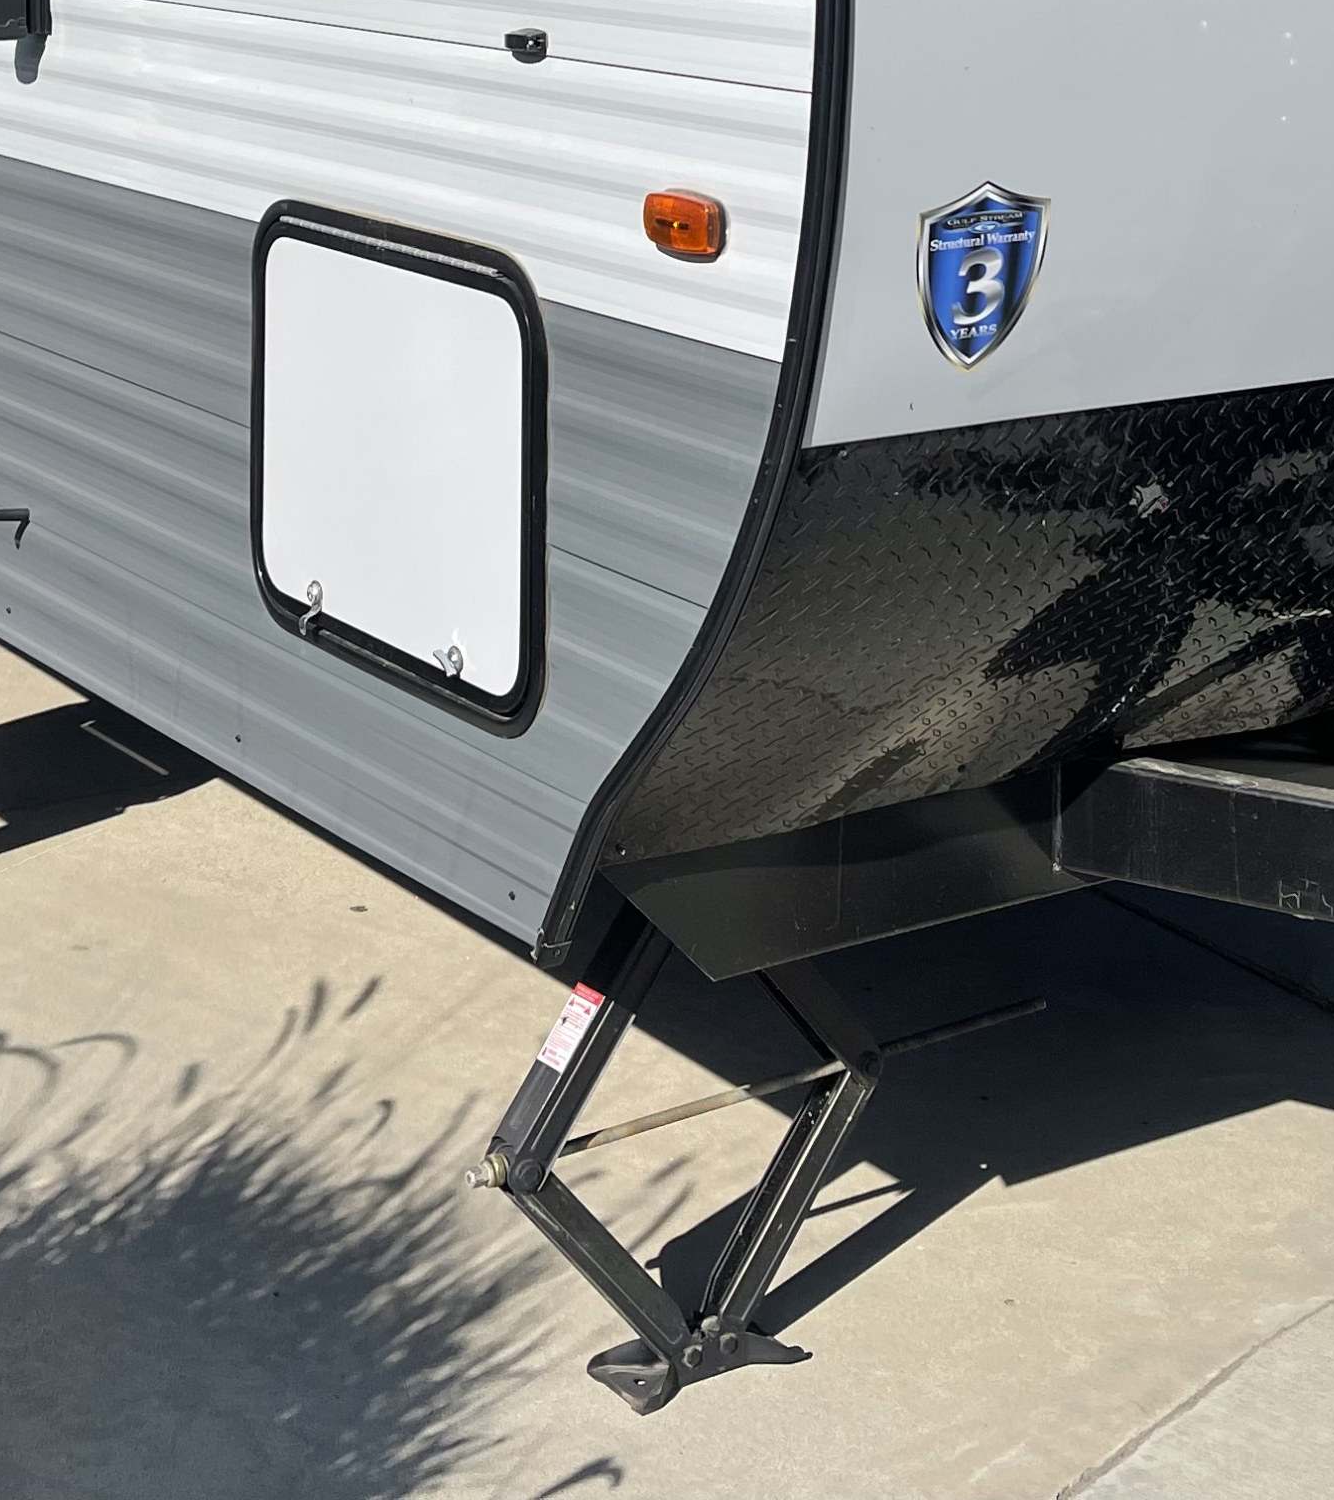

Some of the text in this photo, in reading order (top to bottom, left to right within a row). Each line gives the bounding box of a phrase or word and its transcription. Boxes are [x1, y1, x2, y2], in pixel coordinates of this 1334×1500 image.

[929, 229, 1036, 252] Structural Warranty
[952, 246, 1006, 326] 3
[950, 323, 998, 340] YEARS
